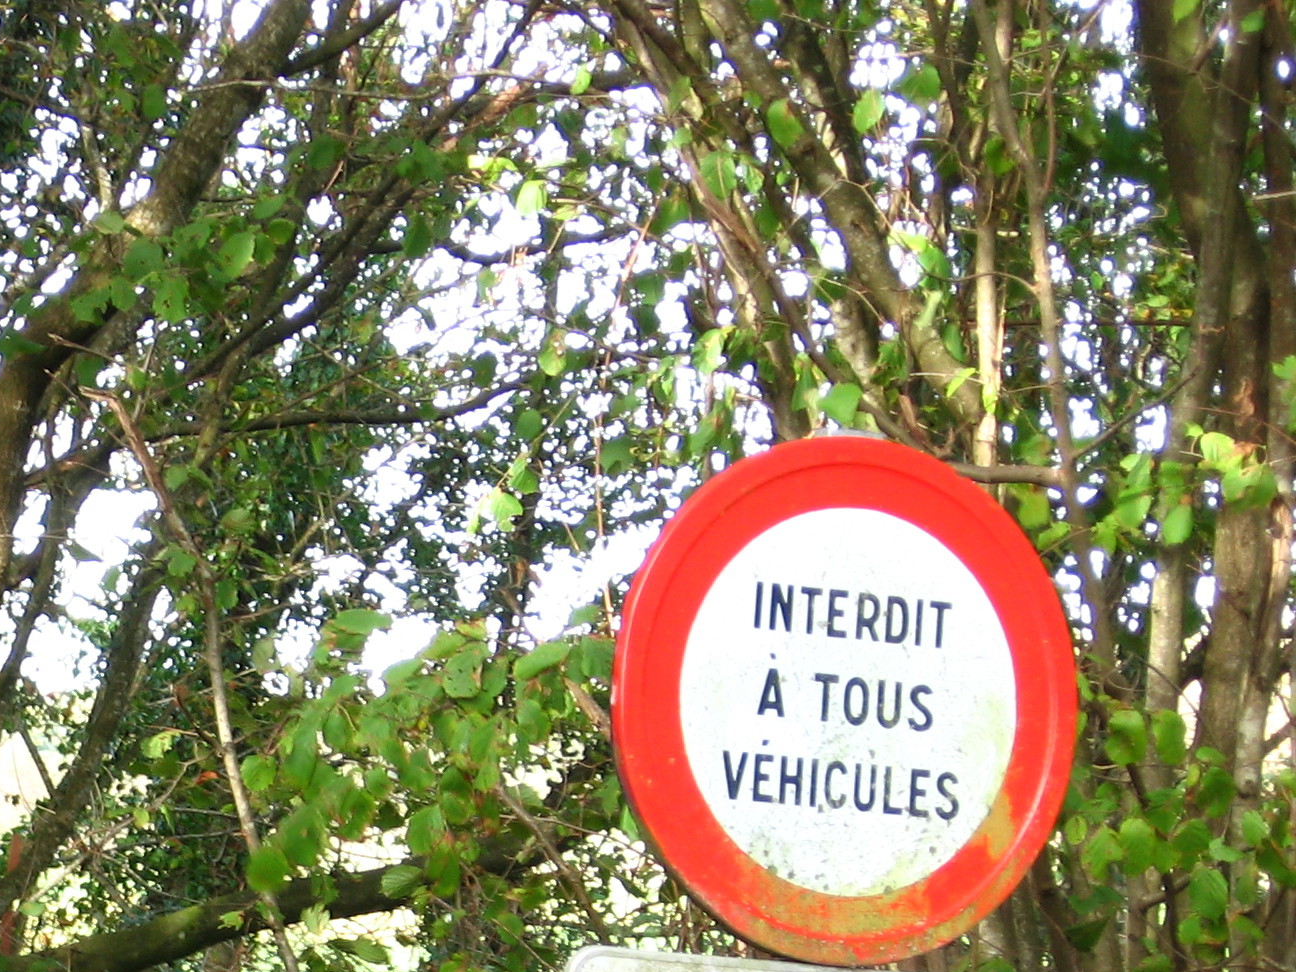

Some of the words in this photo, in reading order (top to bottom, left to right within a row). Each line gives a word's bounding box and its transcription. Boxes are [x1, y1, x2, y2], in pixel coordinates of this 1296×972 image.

[752, 581, 953, 649] INTERDIT
[756, 653, 786, 718] À
[814, 672, 934, 732] TOUS
[722, 739, 960, 821] VÉHICULES
